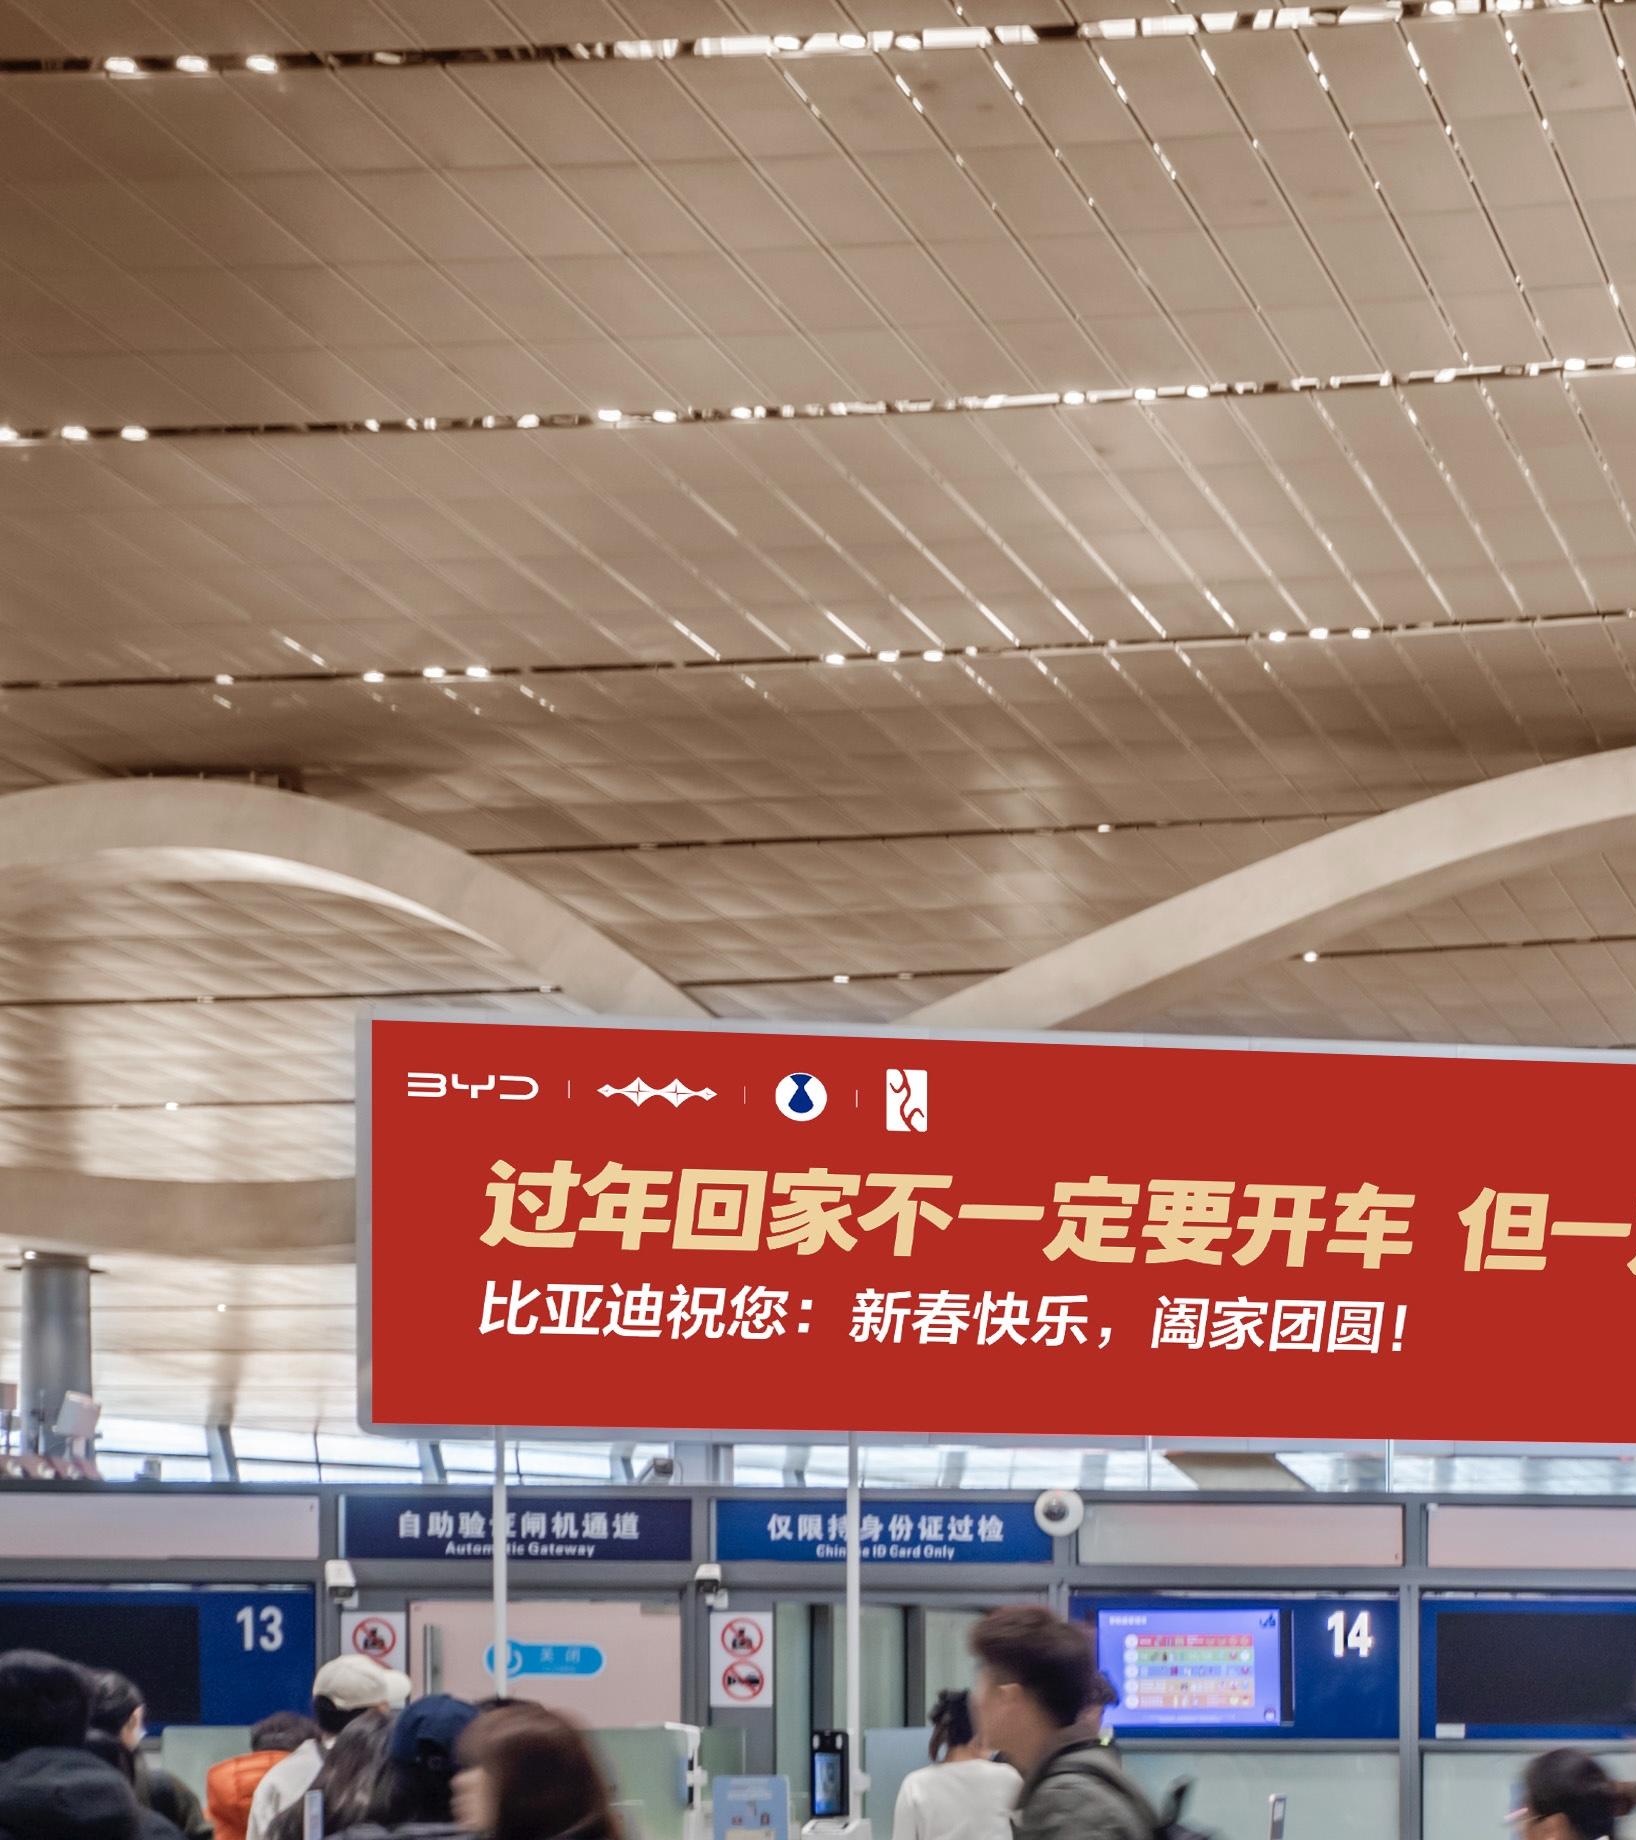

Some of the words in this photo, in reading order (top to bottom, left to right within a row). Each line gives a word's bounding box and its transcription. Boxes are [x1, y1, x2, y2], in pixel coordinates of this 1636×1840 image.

[408, 1072, 539, 1101] BYD
[479, 1158, 1416, 1275] 过年回家不一定要开车
[767, 1513, 1005, 1542] 仅限持身份证过检
[529, 1541, 596, 1560] Gateway
[816, 1544, 868, 1560] Chine
[872, 1545, 886, 1560] ID
[890, 1545, 921, 1561] Card
[924, 1545, 955, 1563] Only
[236, 1606, 284, 1652] 13
[1327, 1610, 1373, 1658] 14
